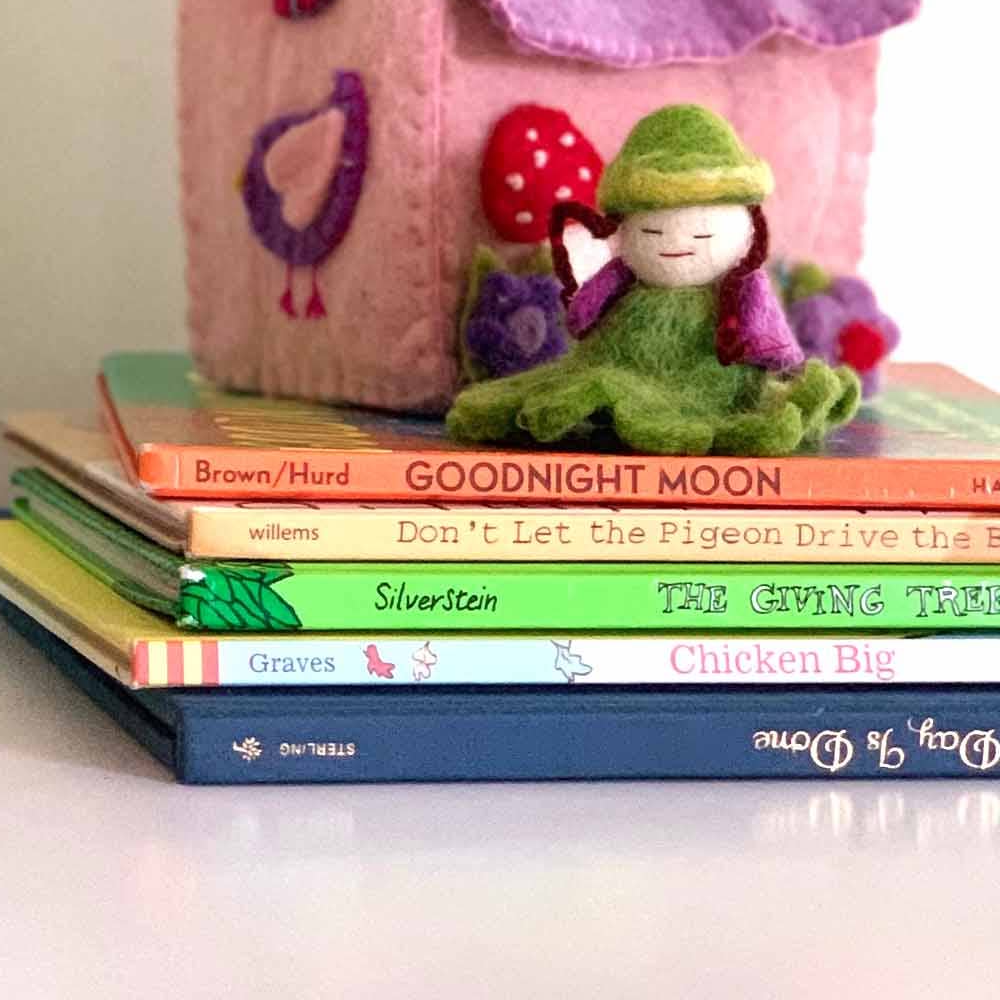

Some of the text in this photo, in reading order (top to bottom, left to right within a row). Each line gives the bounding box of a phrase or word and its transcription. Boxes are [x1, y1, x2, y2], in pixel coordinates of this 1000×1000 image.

[195, 460, 350, 488] Brown/Hurd
[405, 460, 782, 497] GOODNIGHT MOON
[248, 520, 320, 542] willems
[397, 520, 500, 544] Don't
[512, 520, 571, 545] Let
[590, 519, 647, 545] the
[659, 519, 784, 550] Pigeon
[795, 522, 900, 549] Drive
[911, 525, 971, 550] the
[374, 581, 498, 612] Silverstein
[657, 581, 729, 614] THE
[750, 582, 885, 617] GIVING
[248, 652, 336, 674] Graves
[669, 642, 897, 681] Chicken Big
[279, 741, 357, 757] STERLING
[752, 716, 1000, 773] Day Is Done
